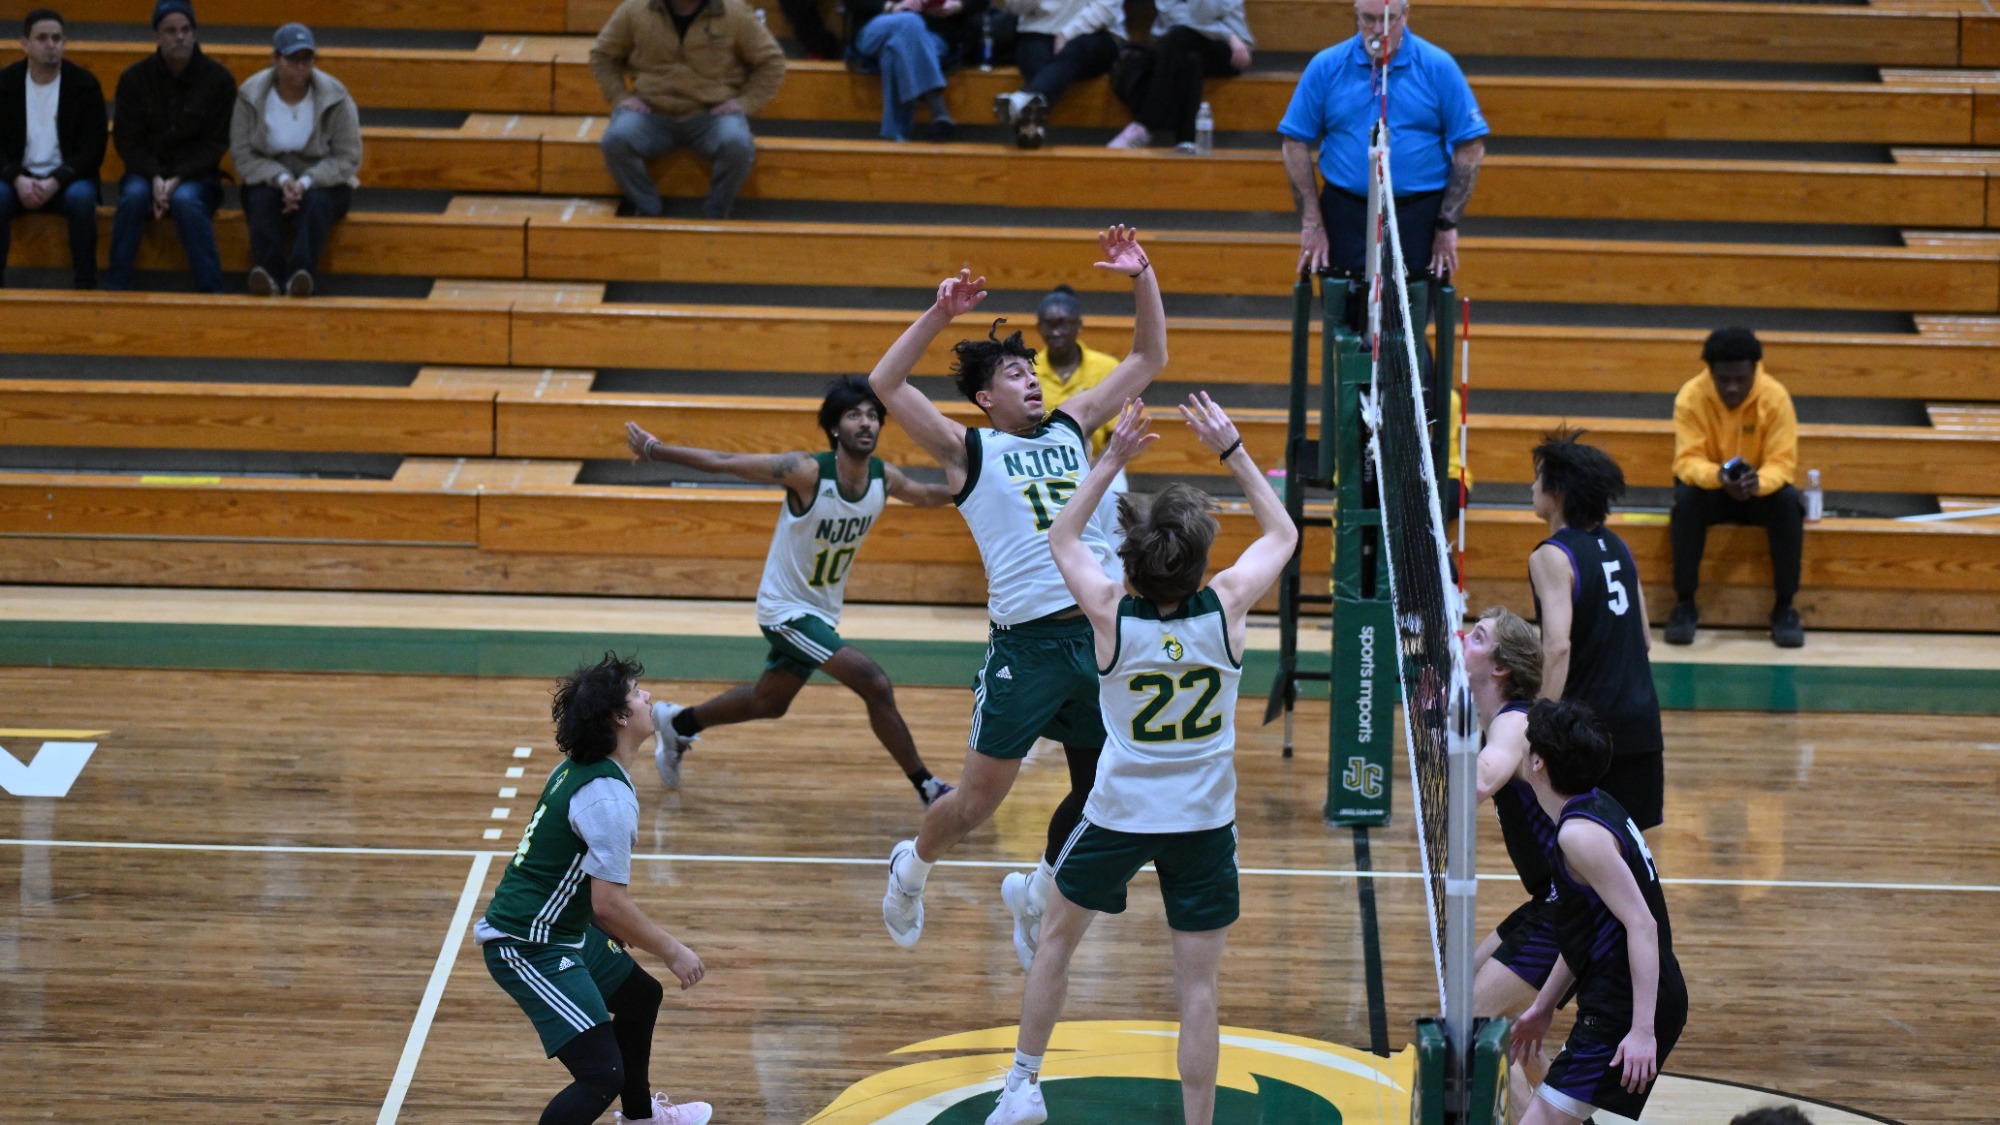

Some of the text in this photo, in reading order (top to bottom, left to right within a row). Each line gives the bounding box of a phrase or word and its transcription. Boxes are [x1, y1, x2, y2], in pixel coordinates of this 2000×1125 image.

[1003, 446, 1079, 477] NJCU
[815, 515, 872, 544] NJCU
[809, 547, 855, 587] 10
[1601, 560, 1629, 615] 5
[1128, 666, 1222, 742] 22
[1356, 625, 1375, 743] sports imports
[1343, 756, 1383, 799] JC
